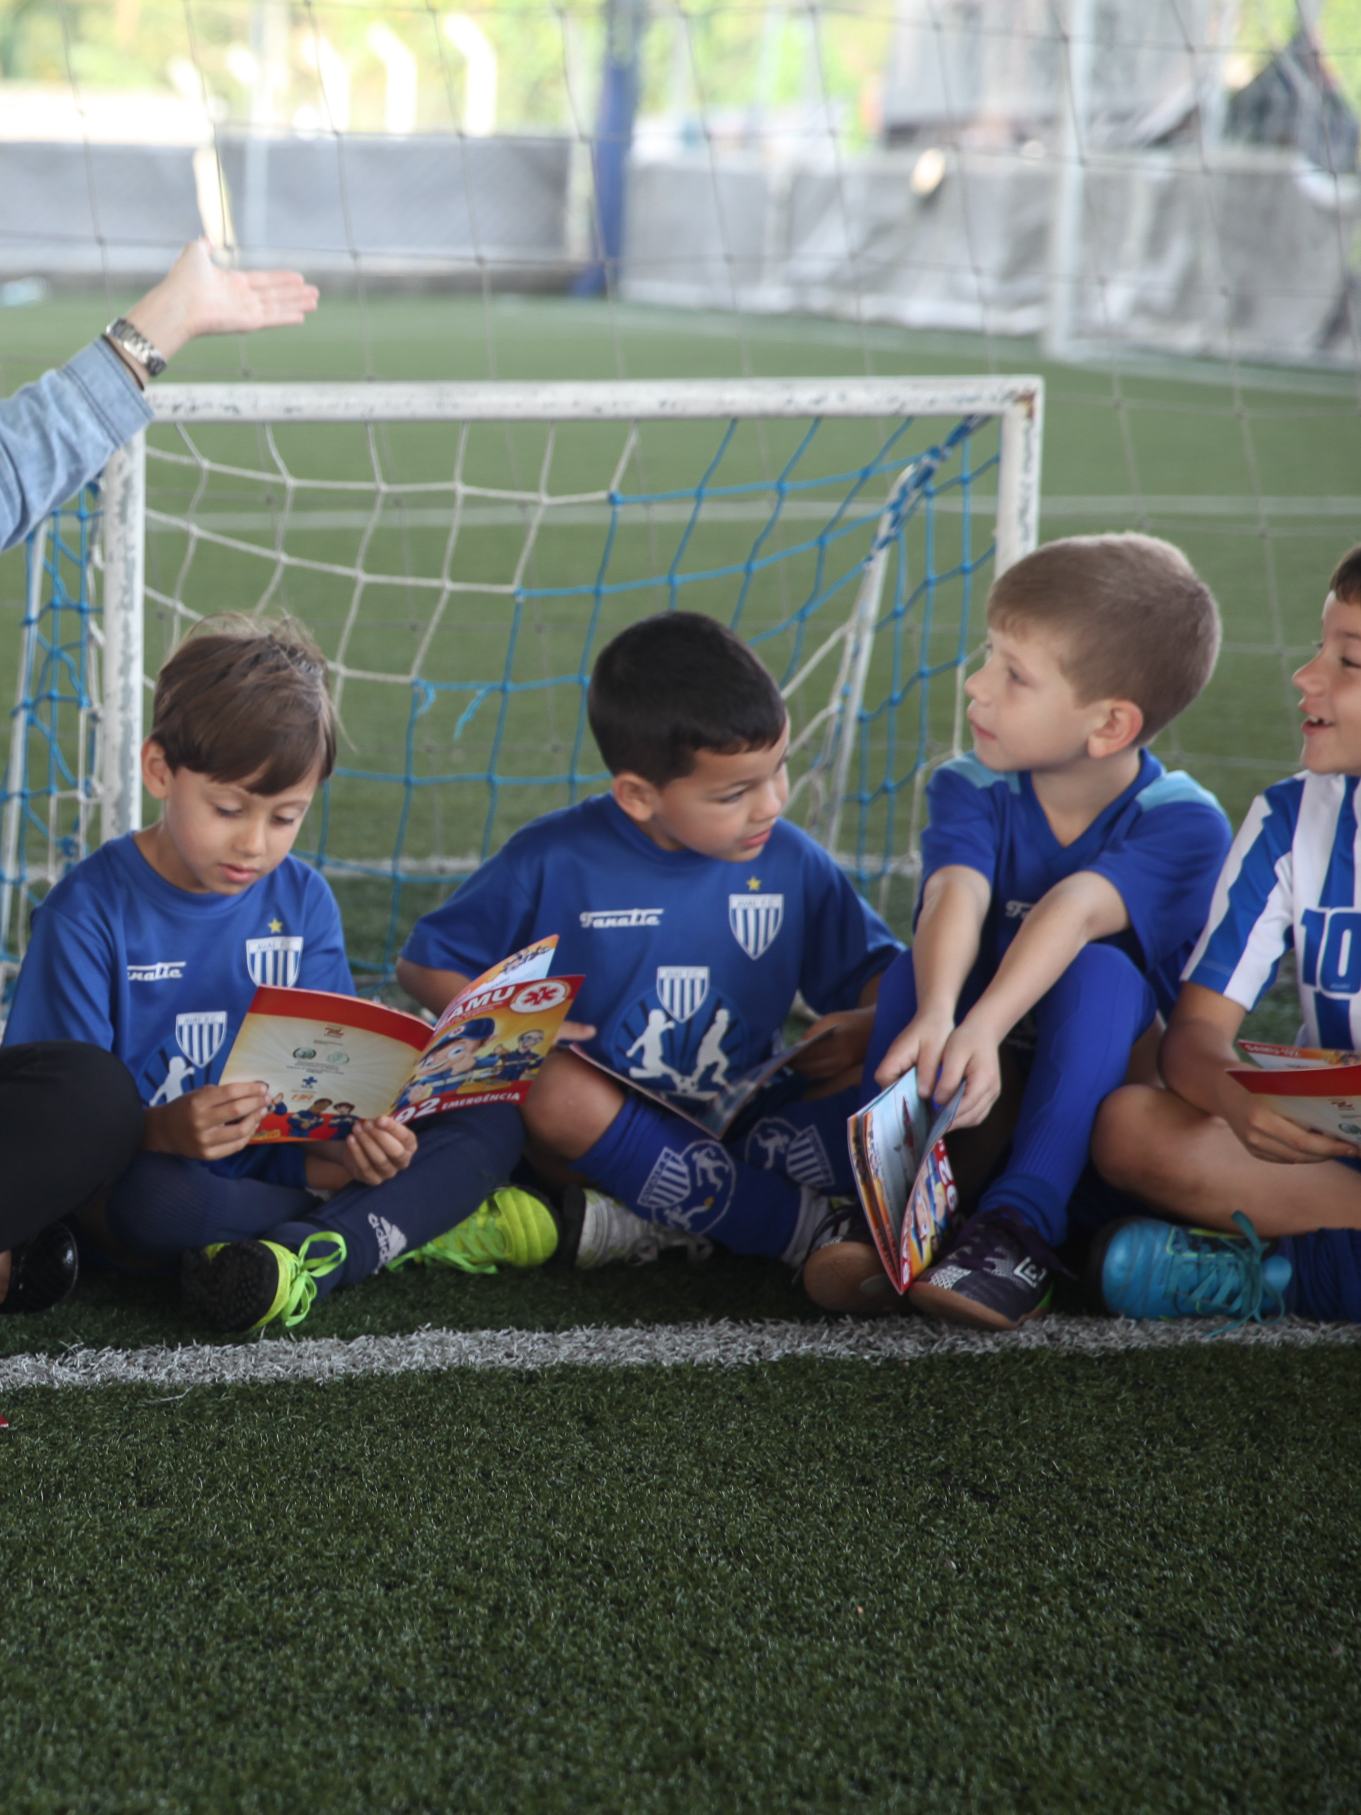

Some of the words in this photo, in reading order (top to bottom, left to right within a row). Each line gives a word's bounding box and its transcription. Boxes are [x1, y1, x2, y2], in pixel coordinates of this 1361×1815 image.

[1300, 908, 1361, 995] 10
[443, 985, 516, 1023] AMU
[394, 1097, 441, 1124] 92
[441, 1092, 521, 1111] EMERGÊNCIA
